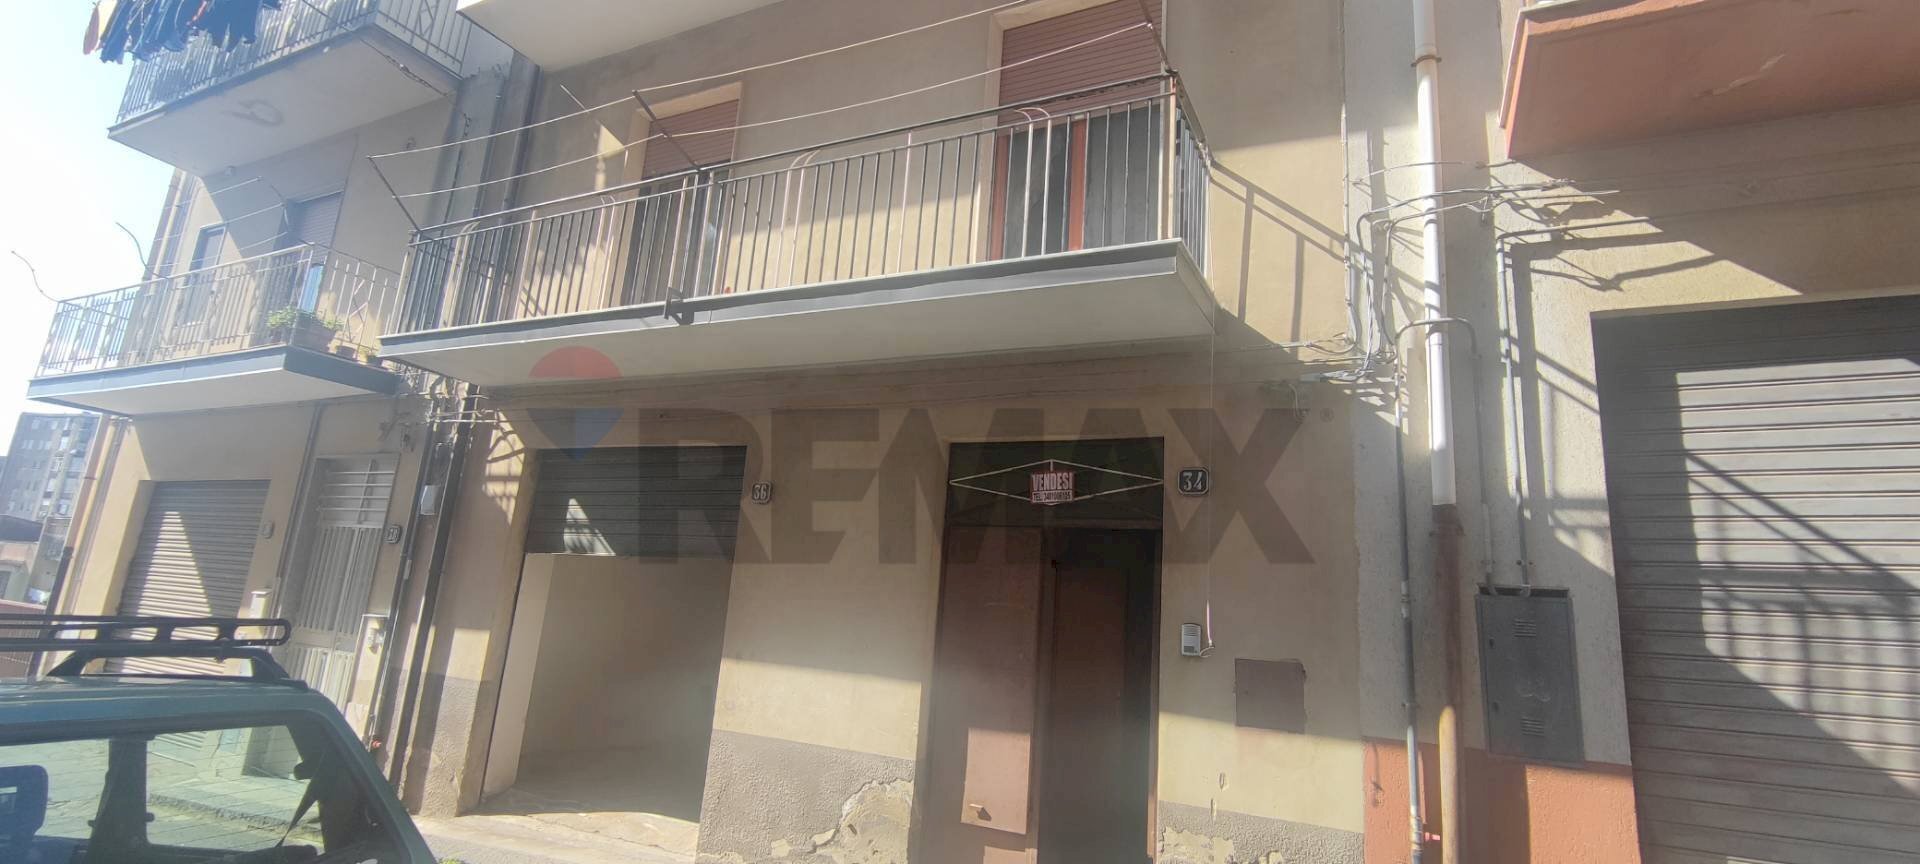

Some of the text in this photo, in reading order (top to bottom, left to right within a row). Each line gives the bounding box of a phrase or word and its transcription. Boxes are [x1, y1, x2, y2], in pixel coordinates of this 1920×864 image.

[1032, 472, 1073, 491] VENDESI
[1183, 471, 1203, 491] 34
[754, 484, 767, 500] 36
